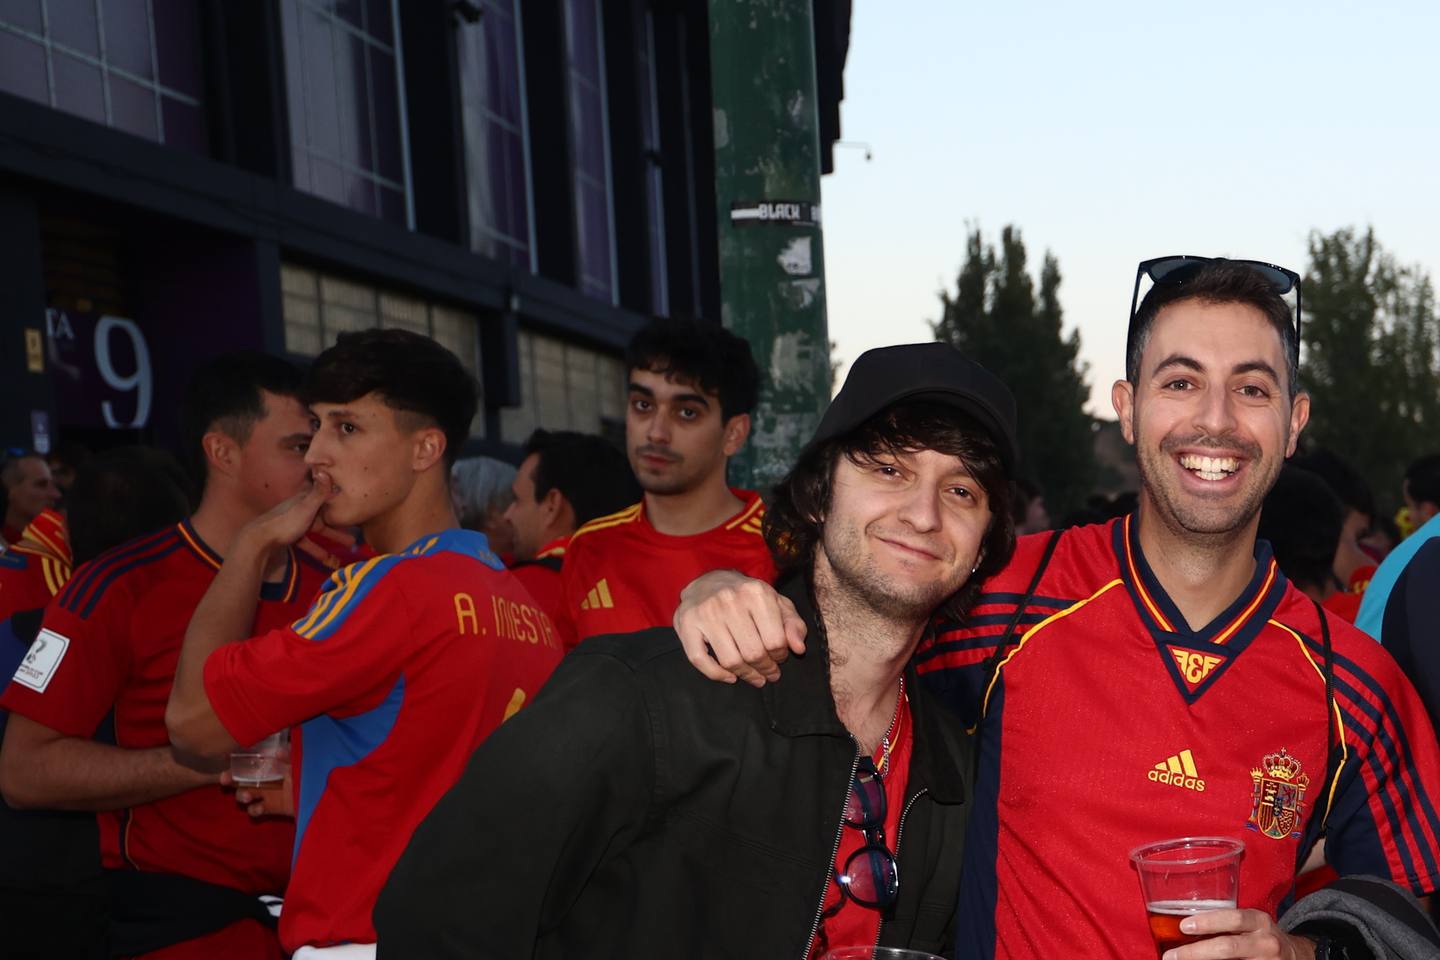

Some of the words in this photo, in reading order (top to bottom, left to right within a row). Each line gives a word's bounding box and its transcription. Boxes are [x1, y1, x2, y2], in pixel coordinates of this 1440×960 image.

[758, 203, 801, 220] BLACK
[94, 315, 153, 430] 9
[453, 592, 487, 636] A.
[1147, 769, 1206, 792] adidas
